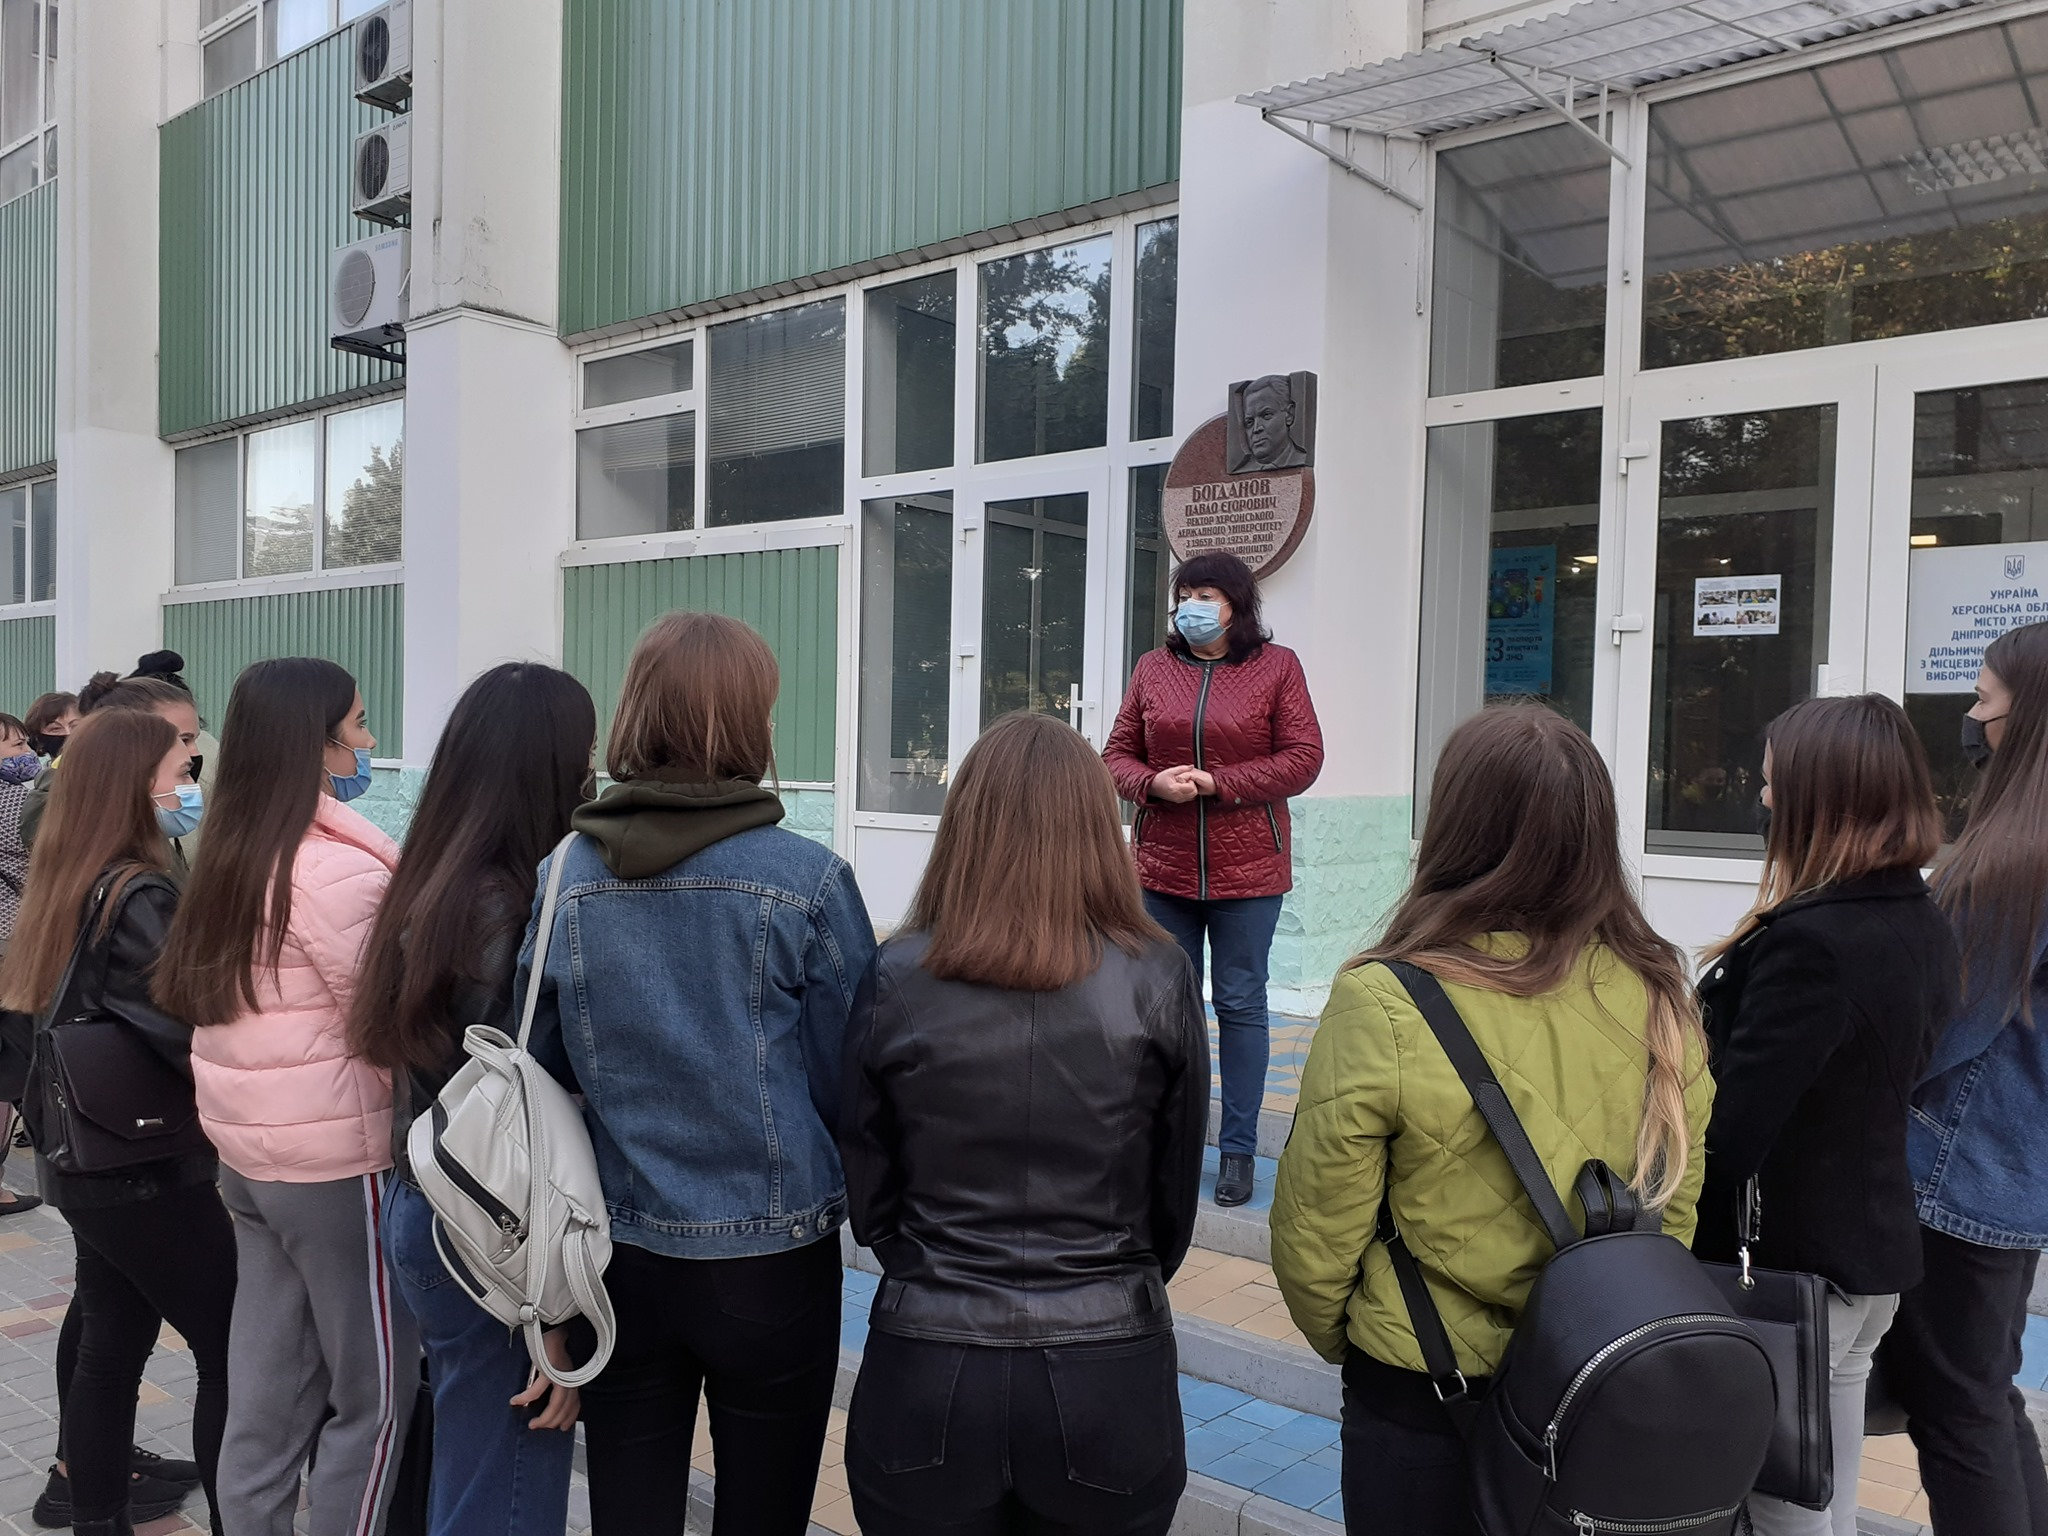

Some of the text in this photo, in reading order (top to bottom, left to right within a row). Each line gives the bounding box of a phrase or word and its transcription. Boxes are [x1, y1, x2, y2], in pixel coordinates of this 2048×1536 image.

[1192, 479, 1271, 502] БОГДАНОВ
[1185, 496, 1277, 517] ПАВЛО ЄГОРОВИЧ
[1186, 516, 1214, 527] РЕКТОР
[1990, 587, 2039, 600] УКРАЇНА
[1951, 604, 2021, 615] ХЕРСОНСЬКА
[1974, 616, 2006, 627] МІСТО
[1951, 629, 2009, 641] ДНІПРОВС
